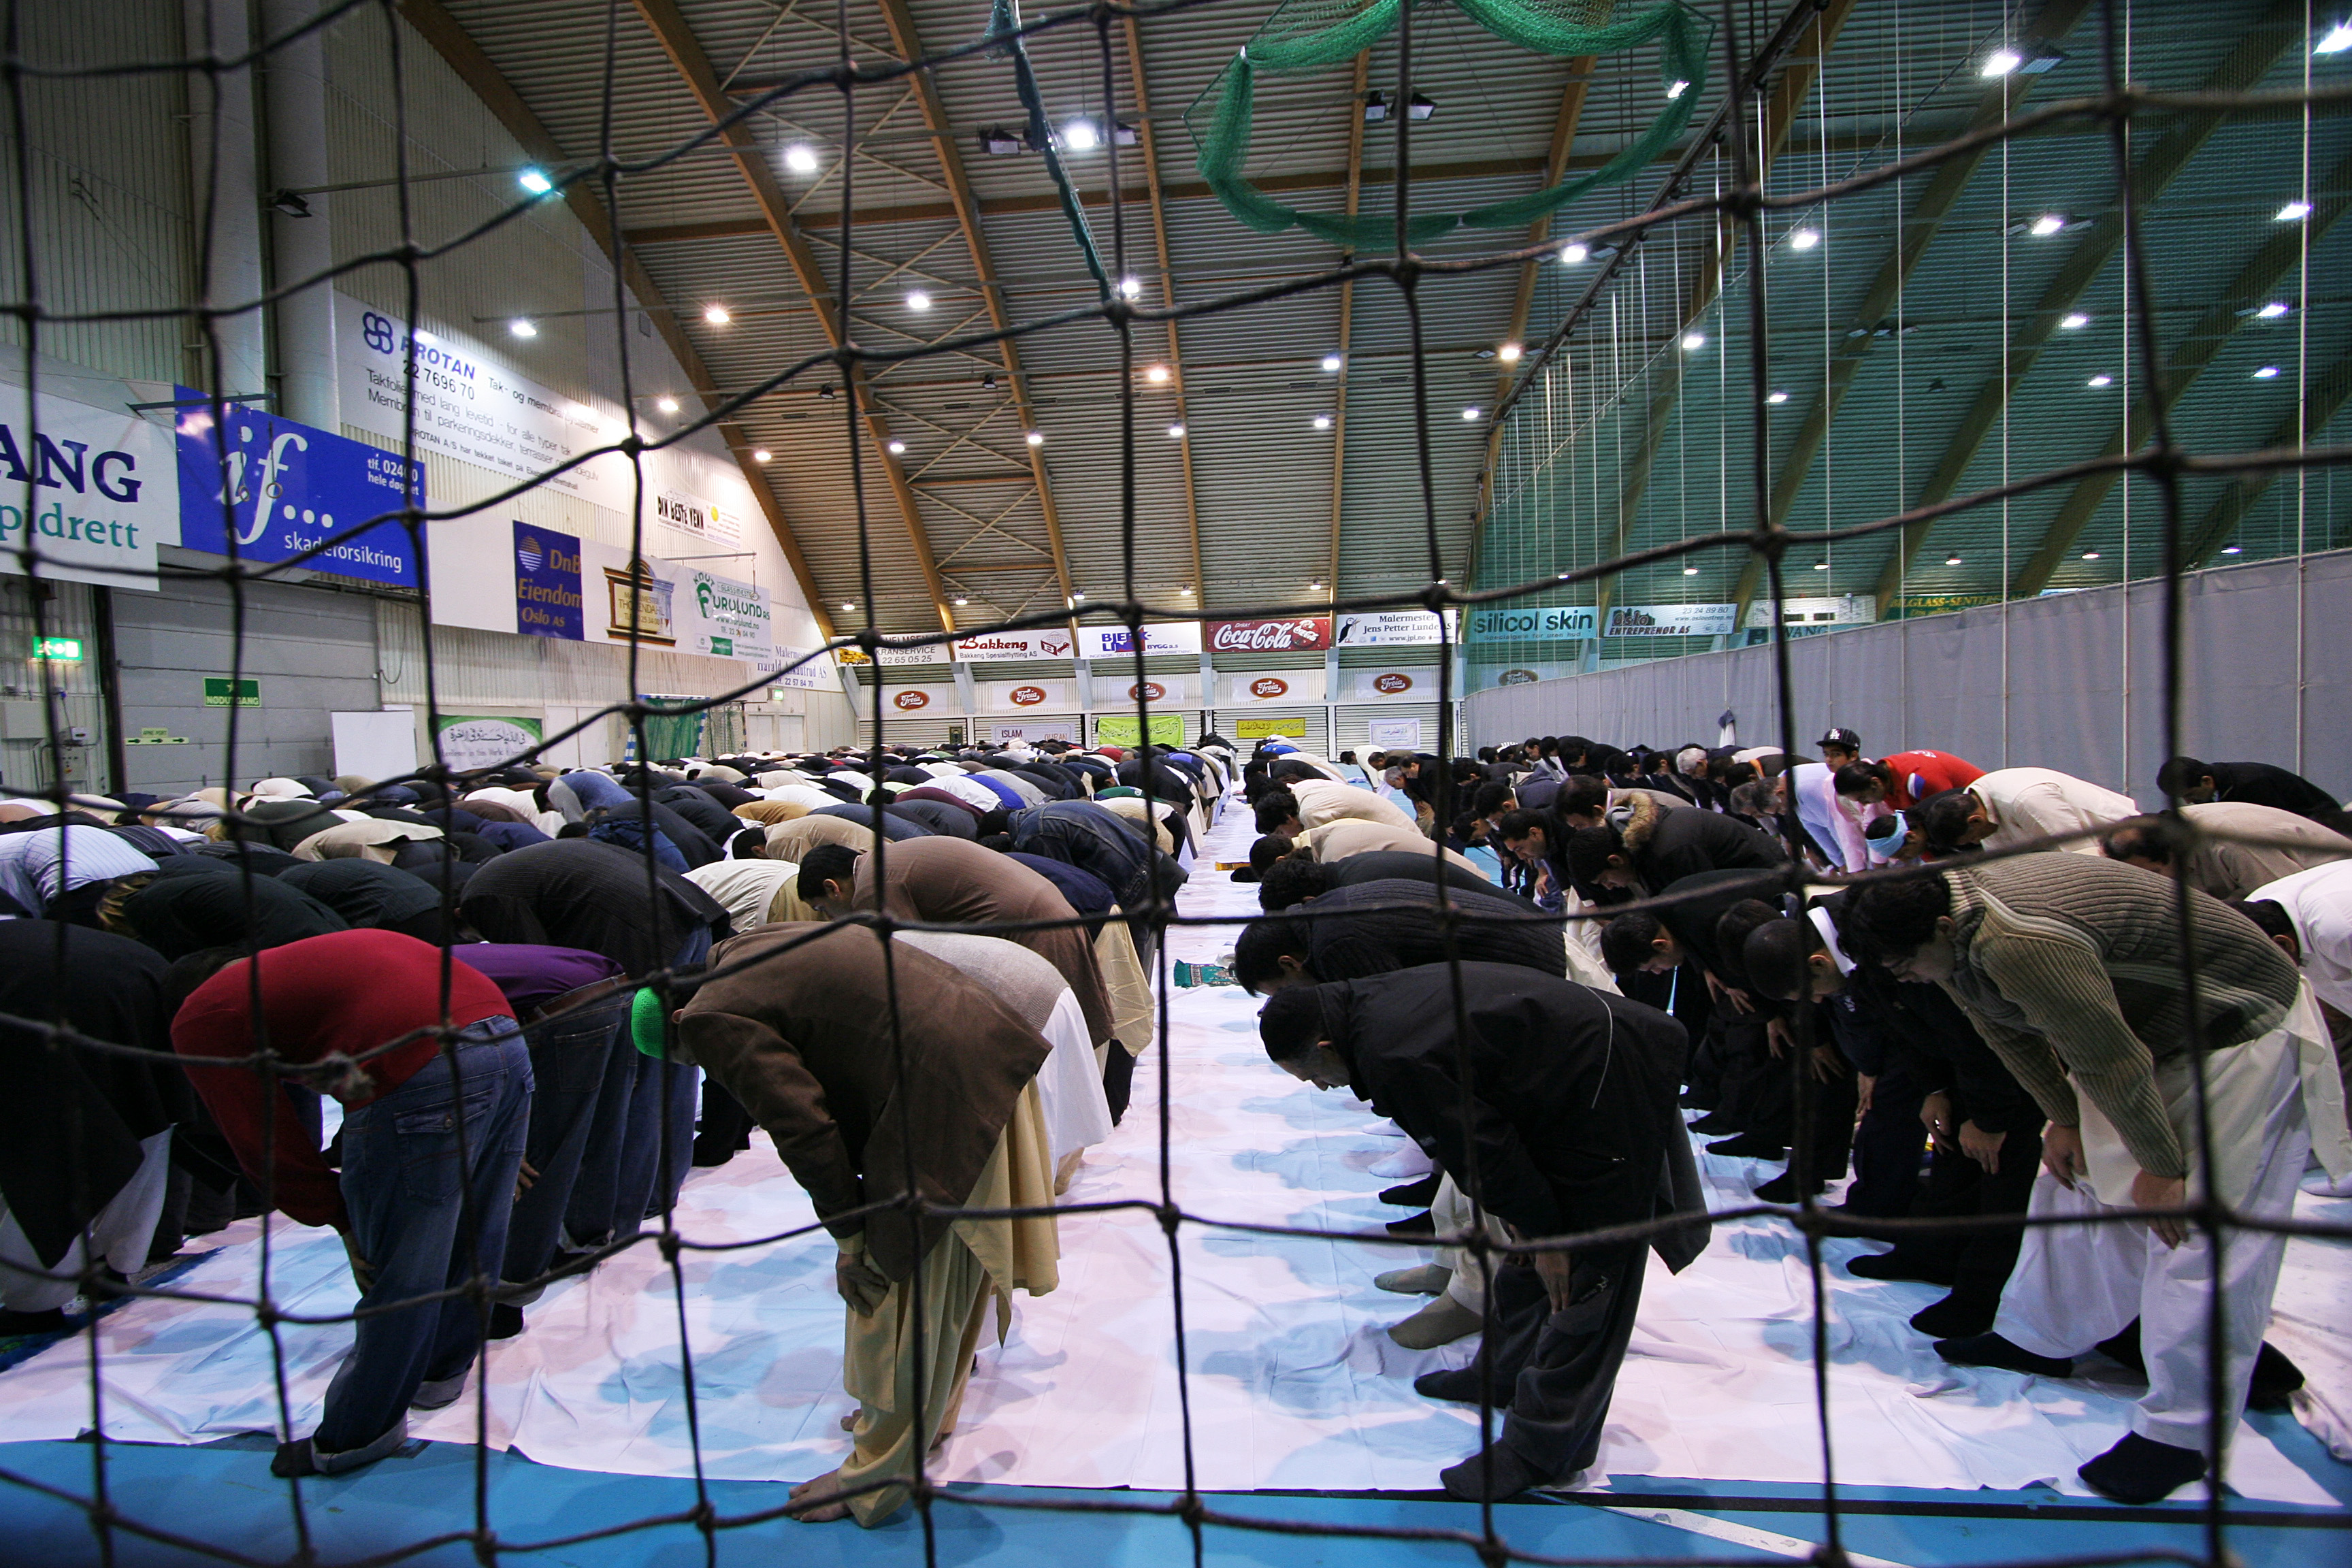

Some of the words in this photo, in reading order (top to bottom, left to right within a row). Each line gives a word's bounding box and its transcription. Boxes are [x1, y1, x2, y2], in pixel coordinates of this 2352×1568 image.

[424, 368, 456, 393] 7696
[460, 383, 474, 400] 70
[512, 391, 525, 404] og
[440, 397, 460, 417] lang
[507, 422, 518, 435] for
[522, 430, 535, 442] alle
[383, 460, 418, 482] 0240
[368, 471, 387, 487] hele
[389, 478, 419, 496] døget
[550, 549, 581, 574] DnB
[521, 607, 549, 625] Oslo
[553, 616, 566, 627] AS
[1379, 614, 1436, 623] Malermester
[1474, 610, 1540, 634] silicol
[1546, 609, 1594, 631] skin
[1612, 610, 1650, 627] Oslo
[1213, 622, 1295, 650] Coca-Cola
[1363, 624, 1382, 634] Jens
[1384, 623, 1410, 632] Petter
[1412, 622, 1439, 631] Lunde
[1678, 625, 1691, 634] AS
[958, 635, 1028, 651] Bakkeng
[785, 677, 791, 685] 22
[818, 666, 827, 679] AS
[1001, 729, 1023, 738] ISLAM
